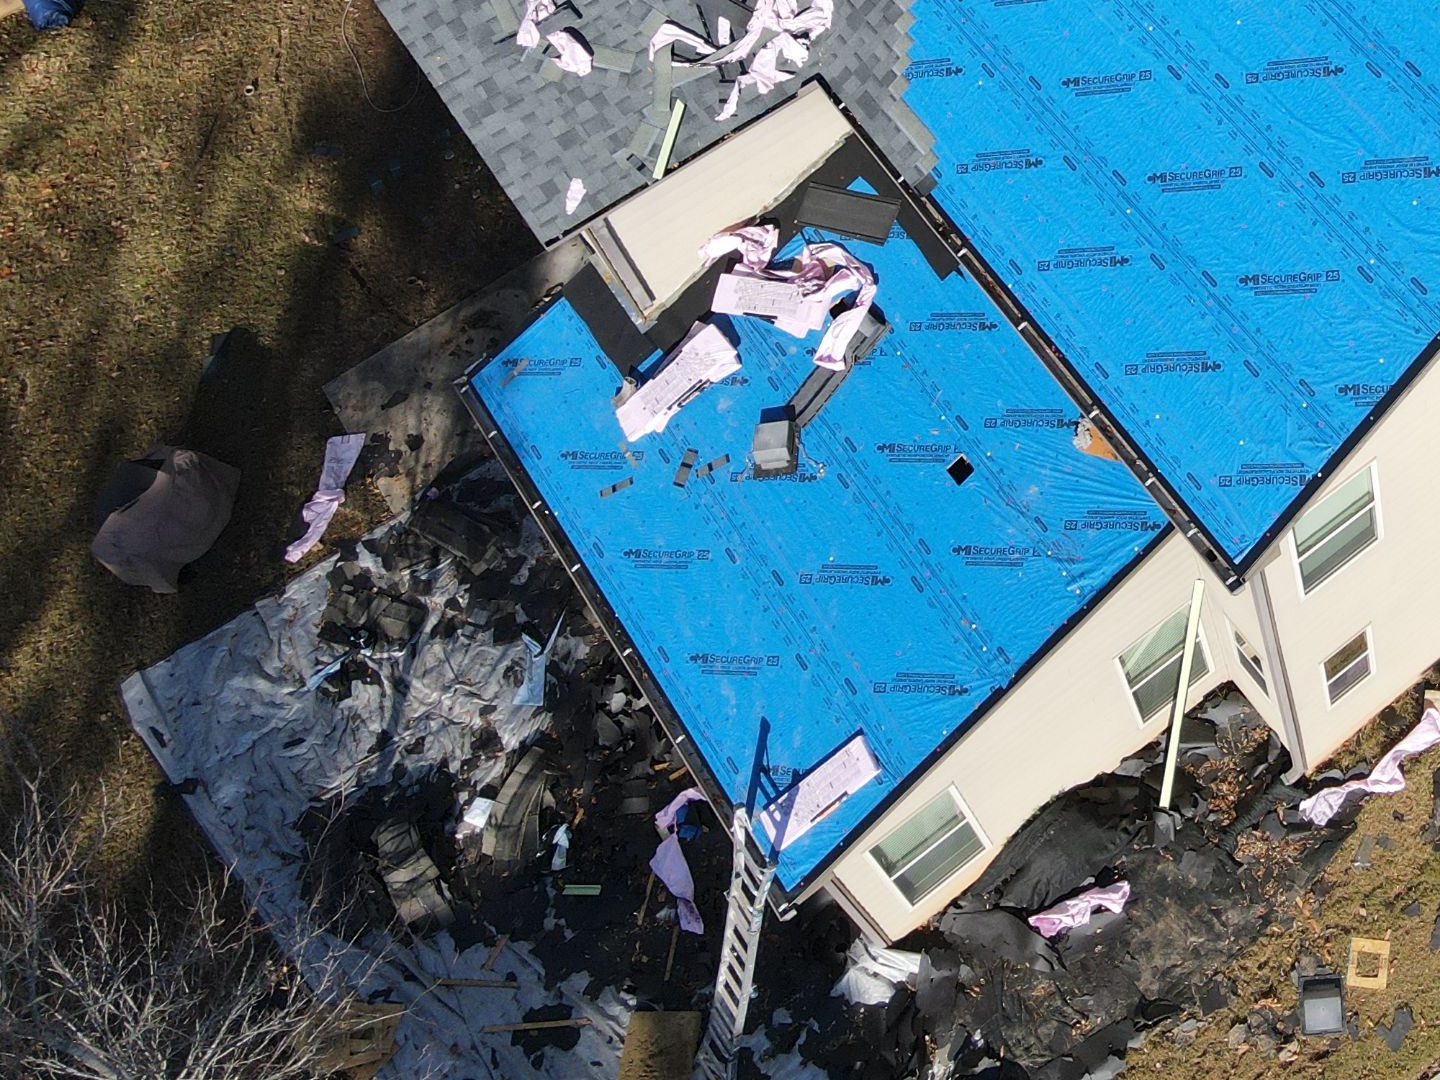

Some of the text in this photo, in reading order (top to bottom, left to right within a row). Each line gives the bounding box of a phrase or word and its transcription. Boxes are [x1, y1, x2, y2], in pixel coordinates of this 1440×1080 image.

[1139, 70, 1151, 79] 25
[1245, 73, 1257, 83] 25
[956, 164, 967, 173] 25
[1229, 166, 1241, 176] 25
[1341, 173, 1355, 182] 25
[1037, 261, 1049, 270] 25
[1326, 270, 1339, 280] 25
[1124, 365, 1137, 374] 25
[984, 419, 996, 427] 25
[1218, 476, 1231, 486] 25
[1064, 520, 1076, 529] 25
[697, 550, 709, 558] 25
[799, 574, 811, 583] 25
[767, 655, 779, 665] 25
[873, 683, 885, 692] 25
